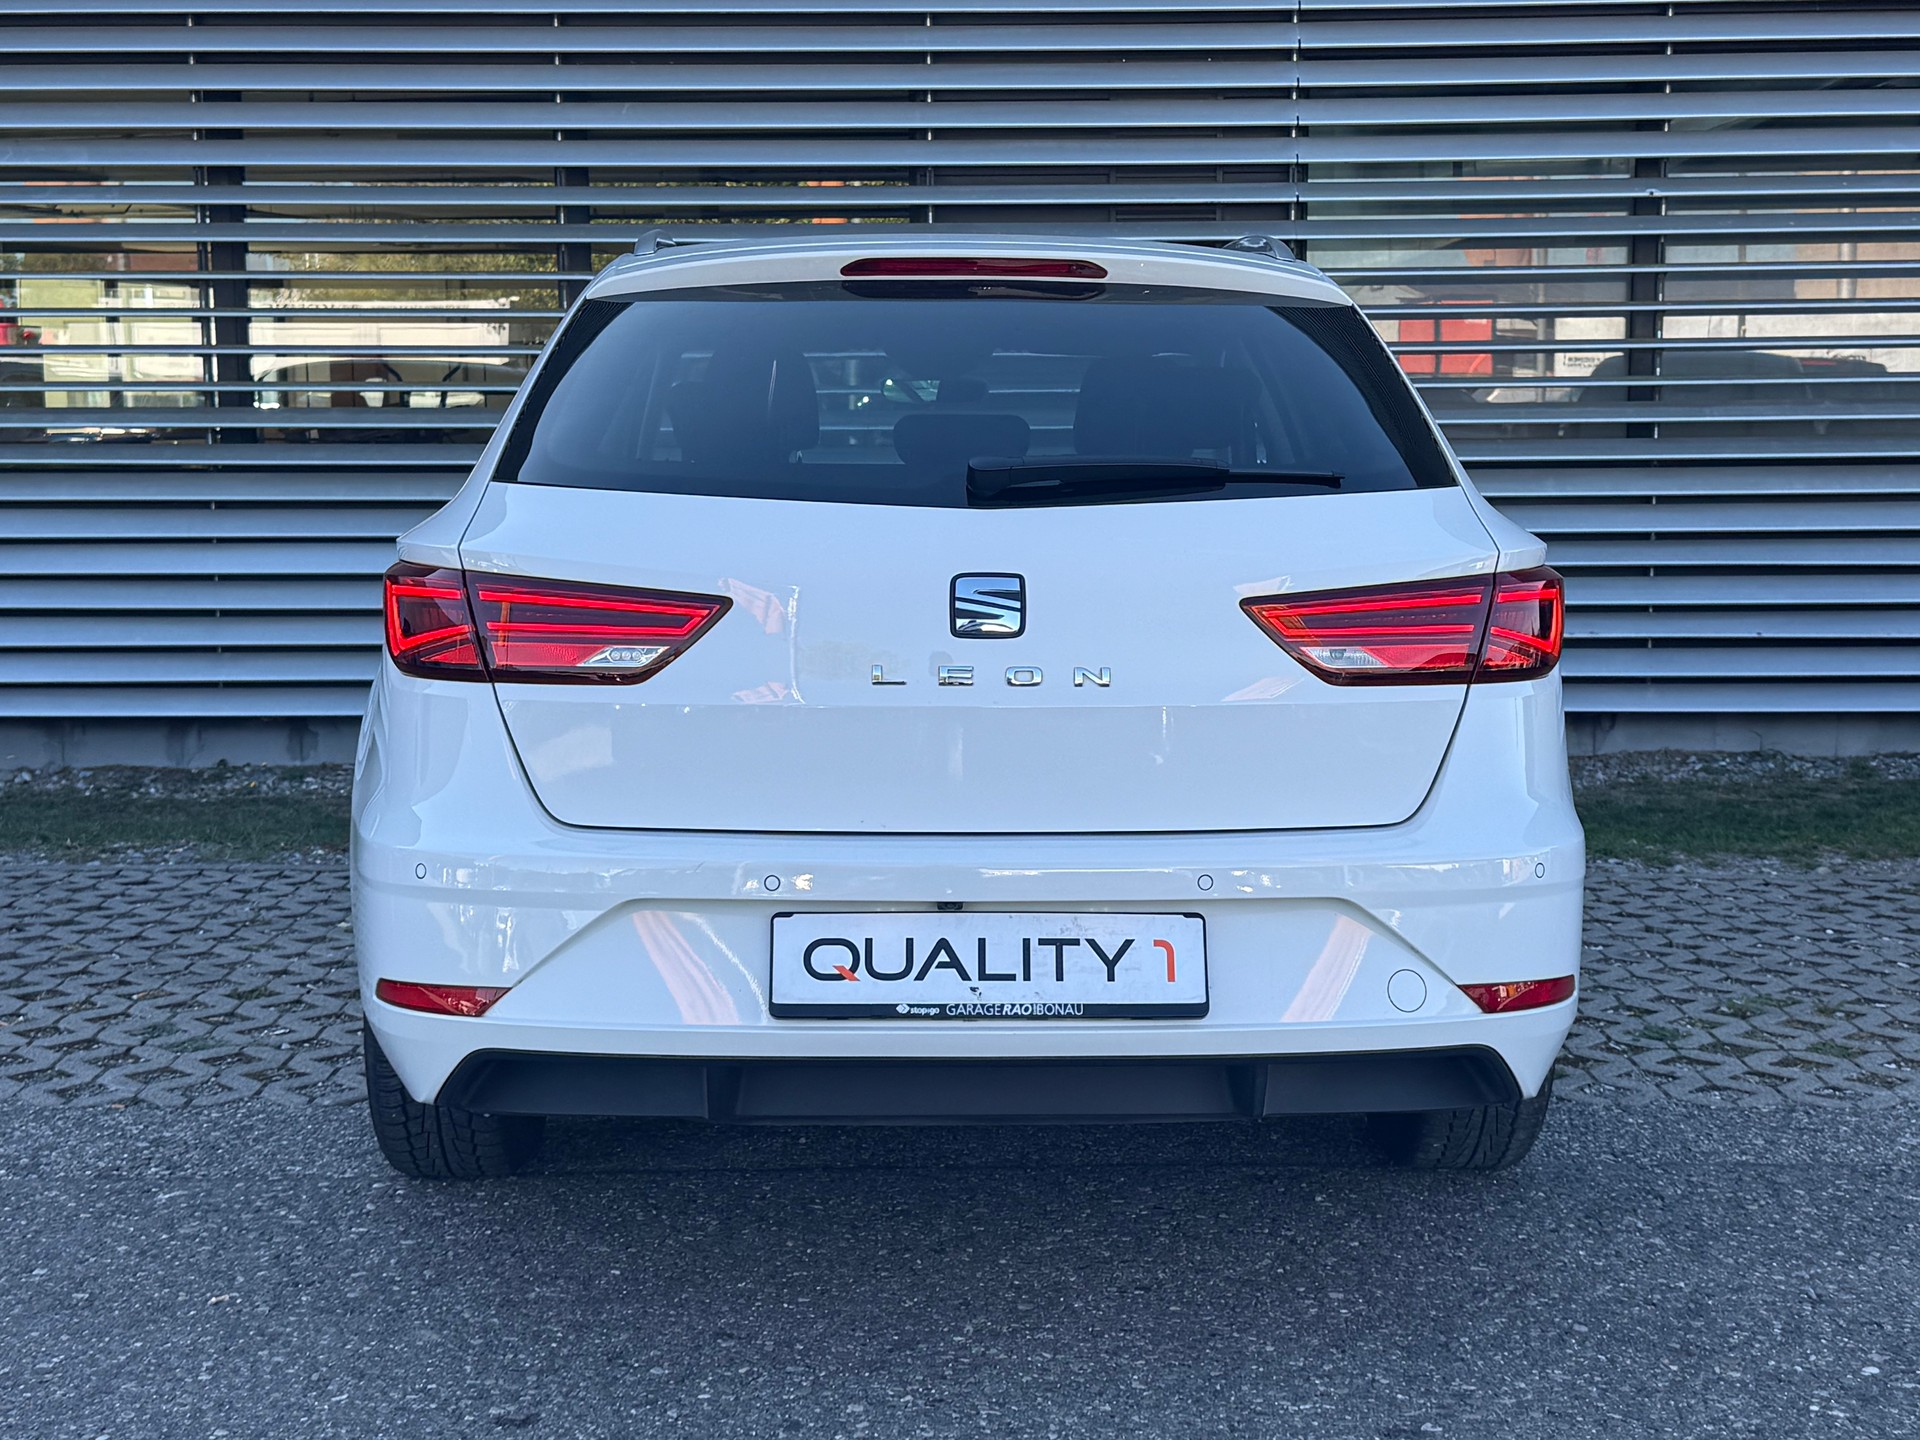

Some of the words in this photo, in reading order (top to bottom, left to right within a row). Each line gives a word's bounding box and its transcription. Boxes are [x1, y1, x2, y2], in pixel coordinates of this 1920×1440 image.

[871, 664, 1112, 687] LEON
[803, 937, 1136, 983] QUALITY
[1153, 939, 1177, 983] 1
